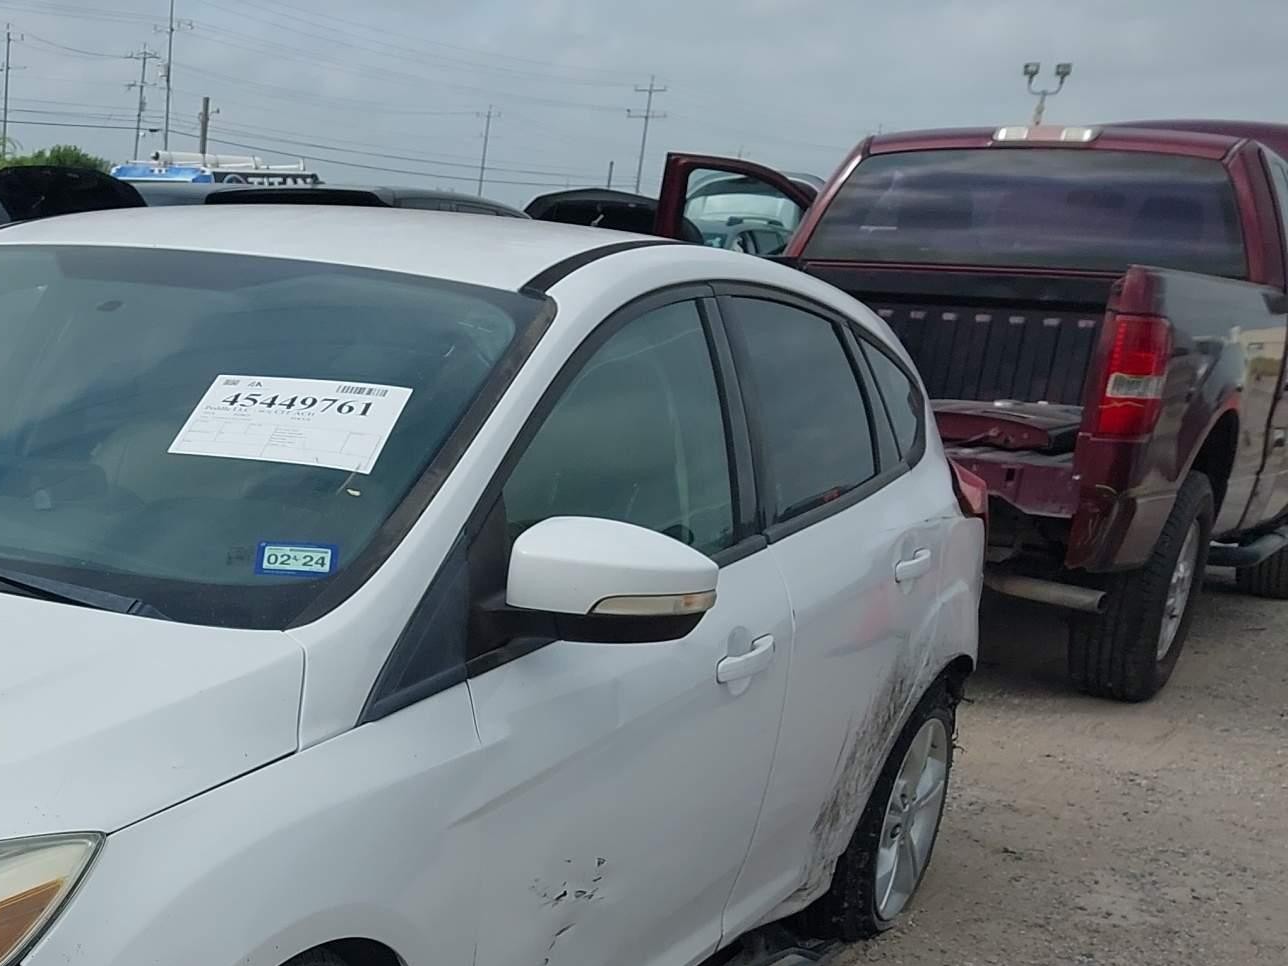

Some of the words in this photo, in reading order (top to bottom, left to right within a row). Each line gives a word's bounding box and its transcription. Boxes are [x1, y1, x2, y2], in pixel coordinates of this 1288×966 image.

[222, 391, 373, 417] 45449761
[267, 553, 292, 566] 02
[302, 554, 327, 568] 24
